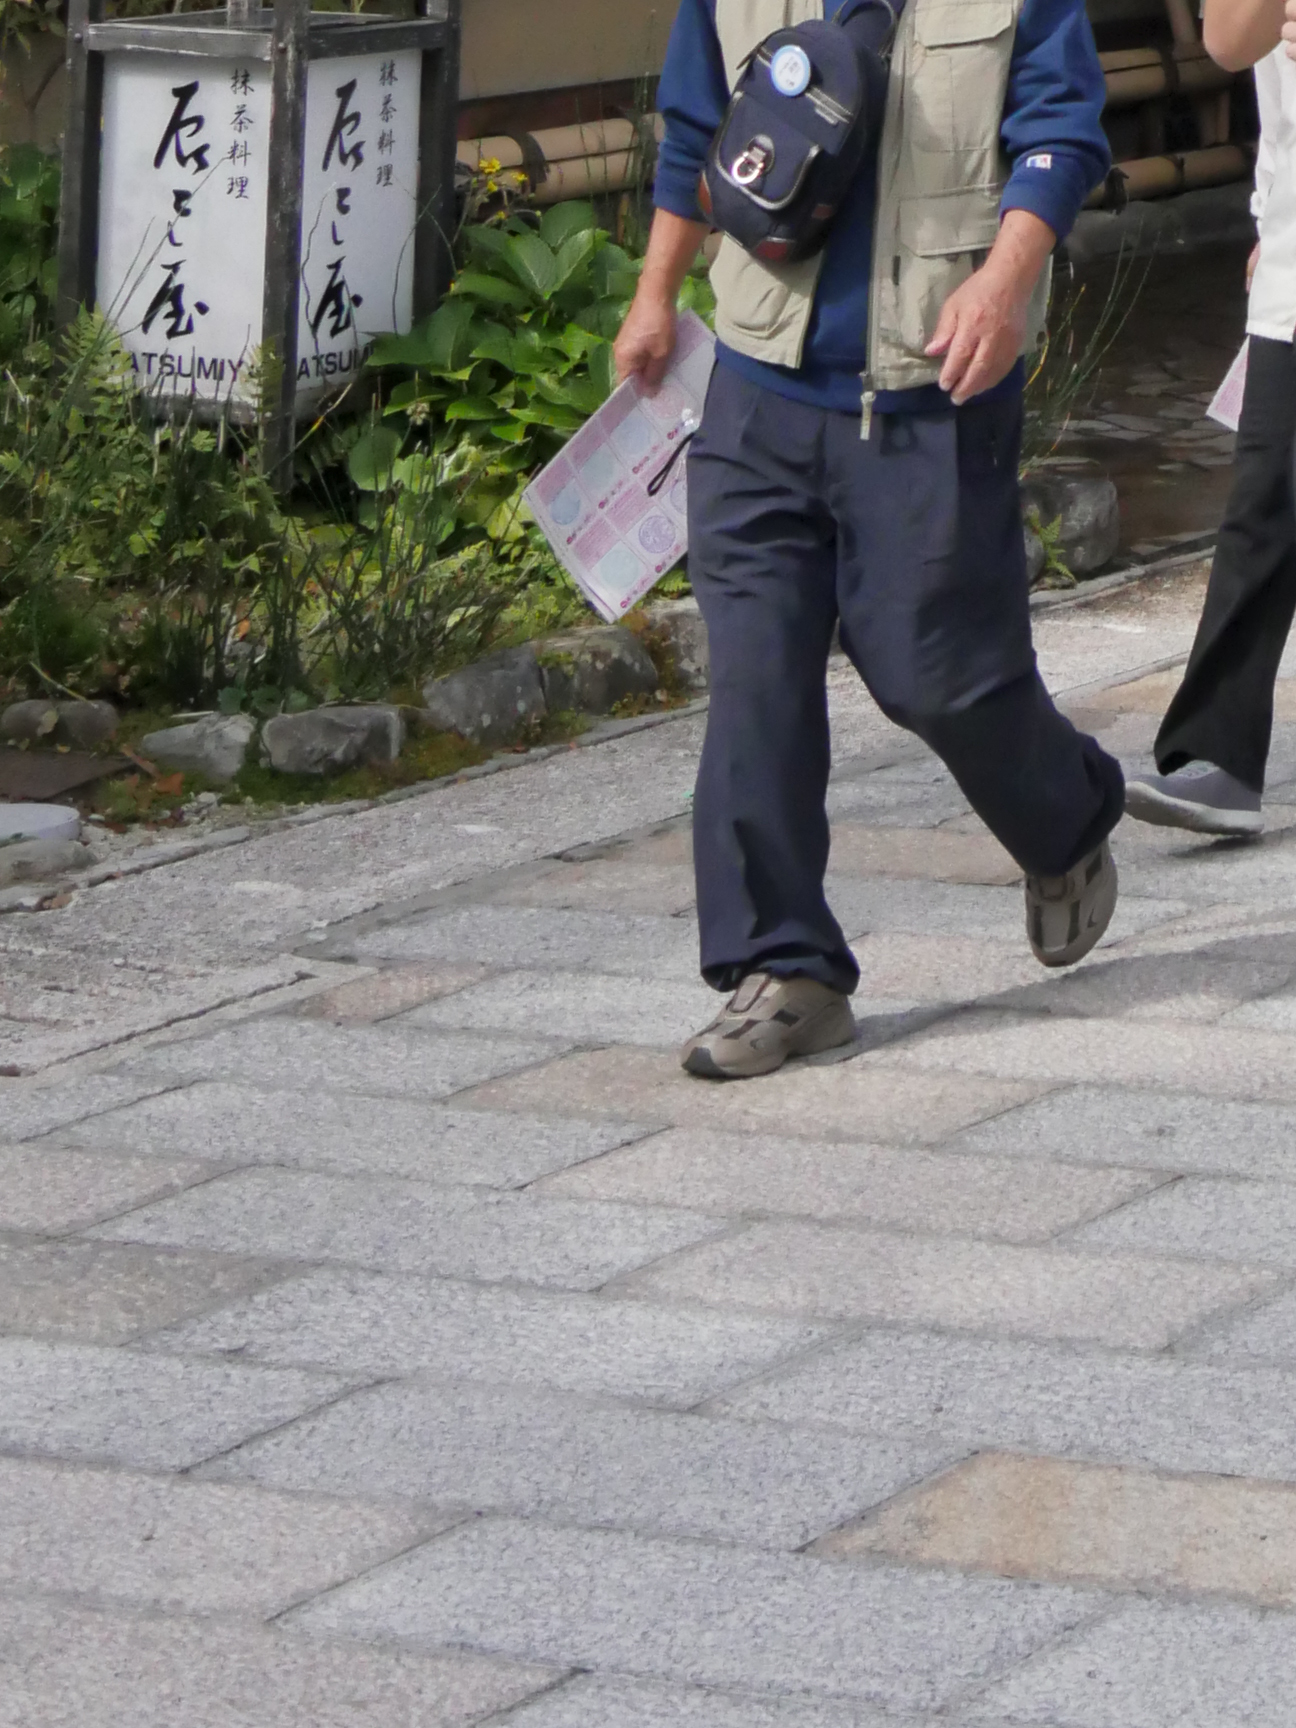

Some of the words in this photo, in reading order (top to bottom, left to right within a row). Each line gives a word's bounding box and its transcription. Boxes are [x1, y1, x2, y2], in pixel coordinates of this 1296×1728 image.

[227, 68, 254, 200] 抹茶料理
[377, 60, 399, 189] 抹茶料理
